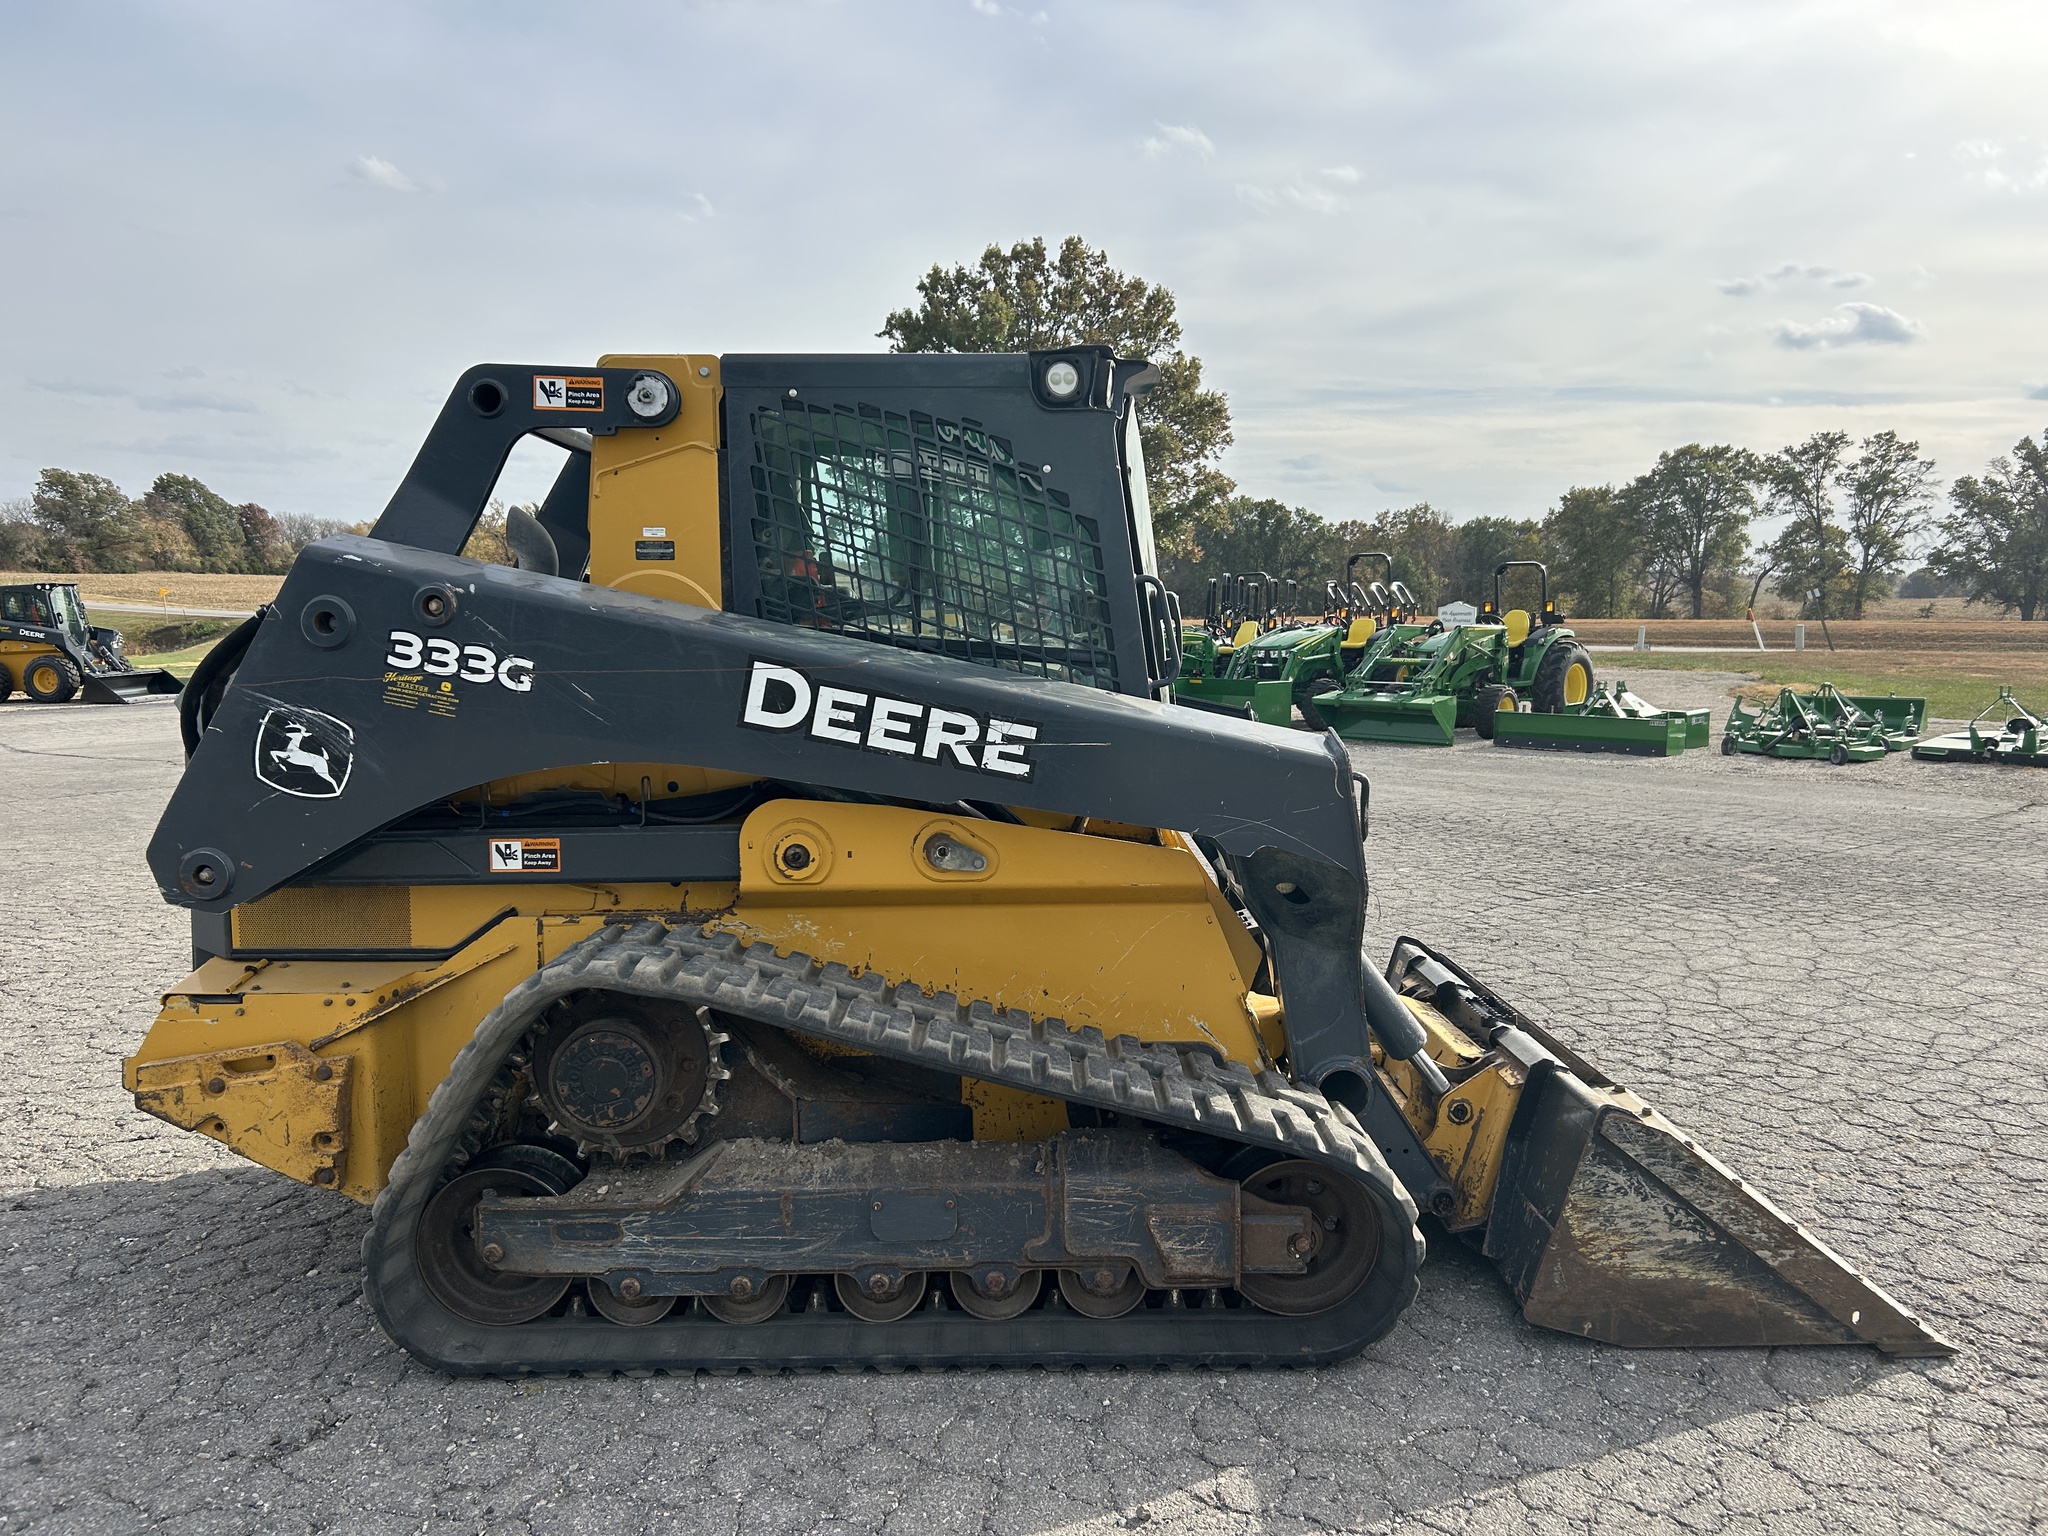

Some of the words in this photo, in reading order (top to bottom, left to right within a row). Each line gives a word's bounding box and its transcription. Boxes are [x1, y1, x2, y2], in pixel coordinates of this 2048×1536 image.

[19, 628, 45, 639] DEERE
[386, 631, 535, 692] 333G
[382, 671, 424, 684] Heritage
[396, 681, 430, 693] TRACTOR
[743, 660, 1038, 777] DEERE
